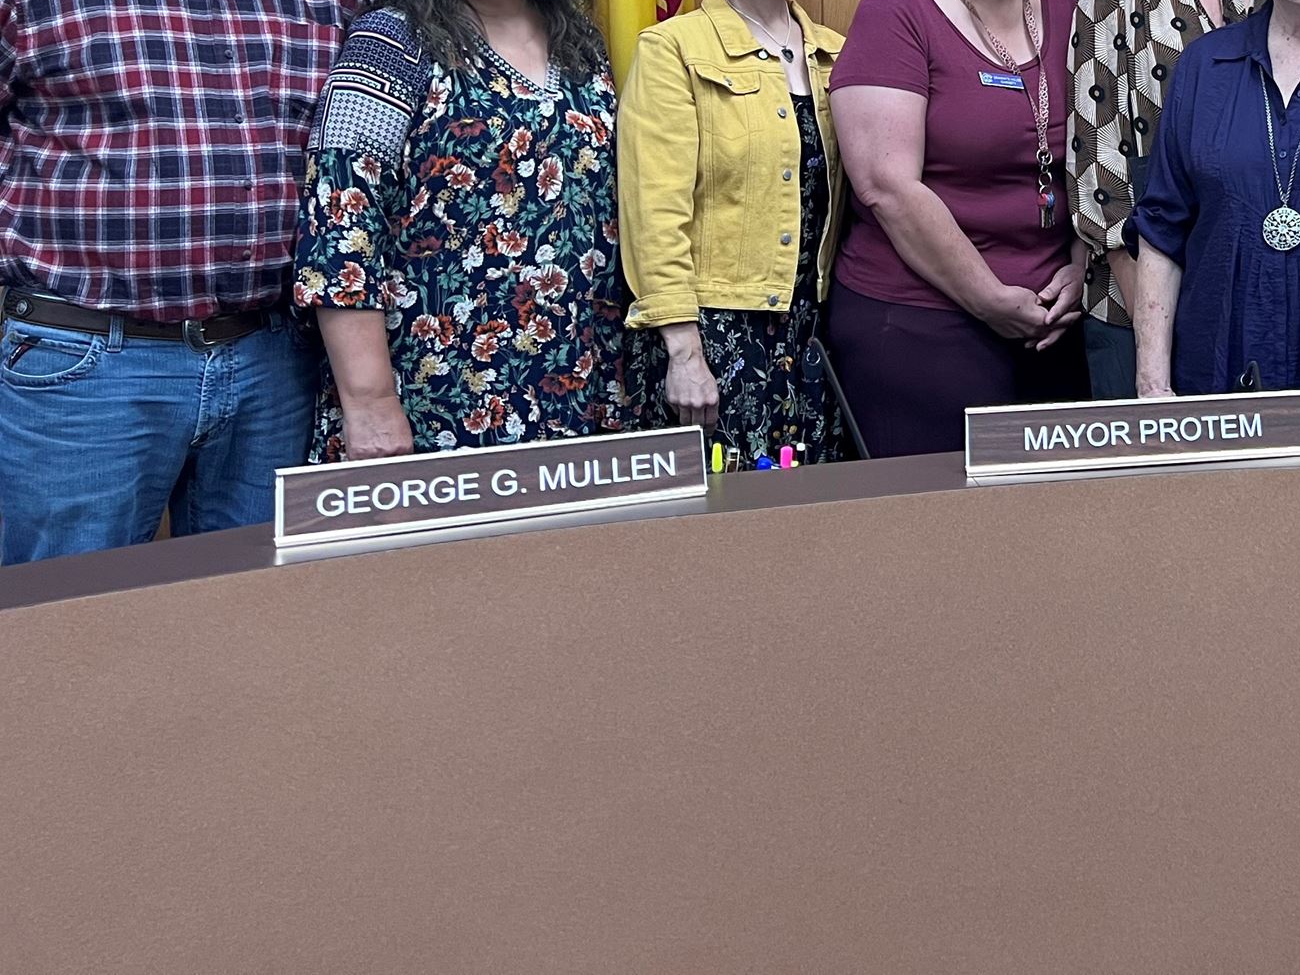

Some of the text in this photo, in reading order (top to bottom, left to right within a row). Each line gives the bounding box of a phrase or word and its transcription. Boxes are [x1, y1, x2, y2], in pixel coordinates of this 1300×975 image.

[1023, 413, 1263, 452] MAYOR PROTEM
[315, 450, 678, 518] GEORGE G. MULLEN
